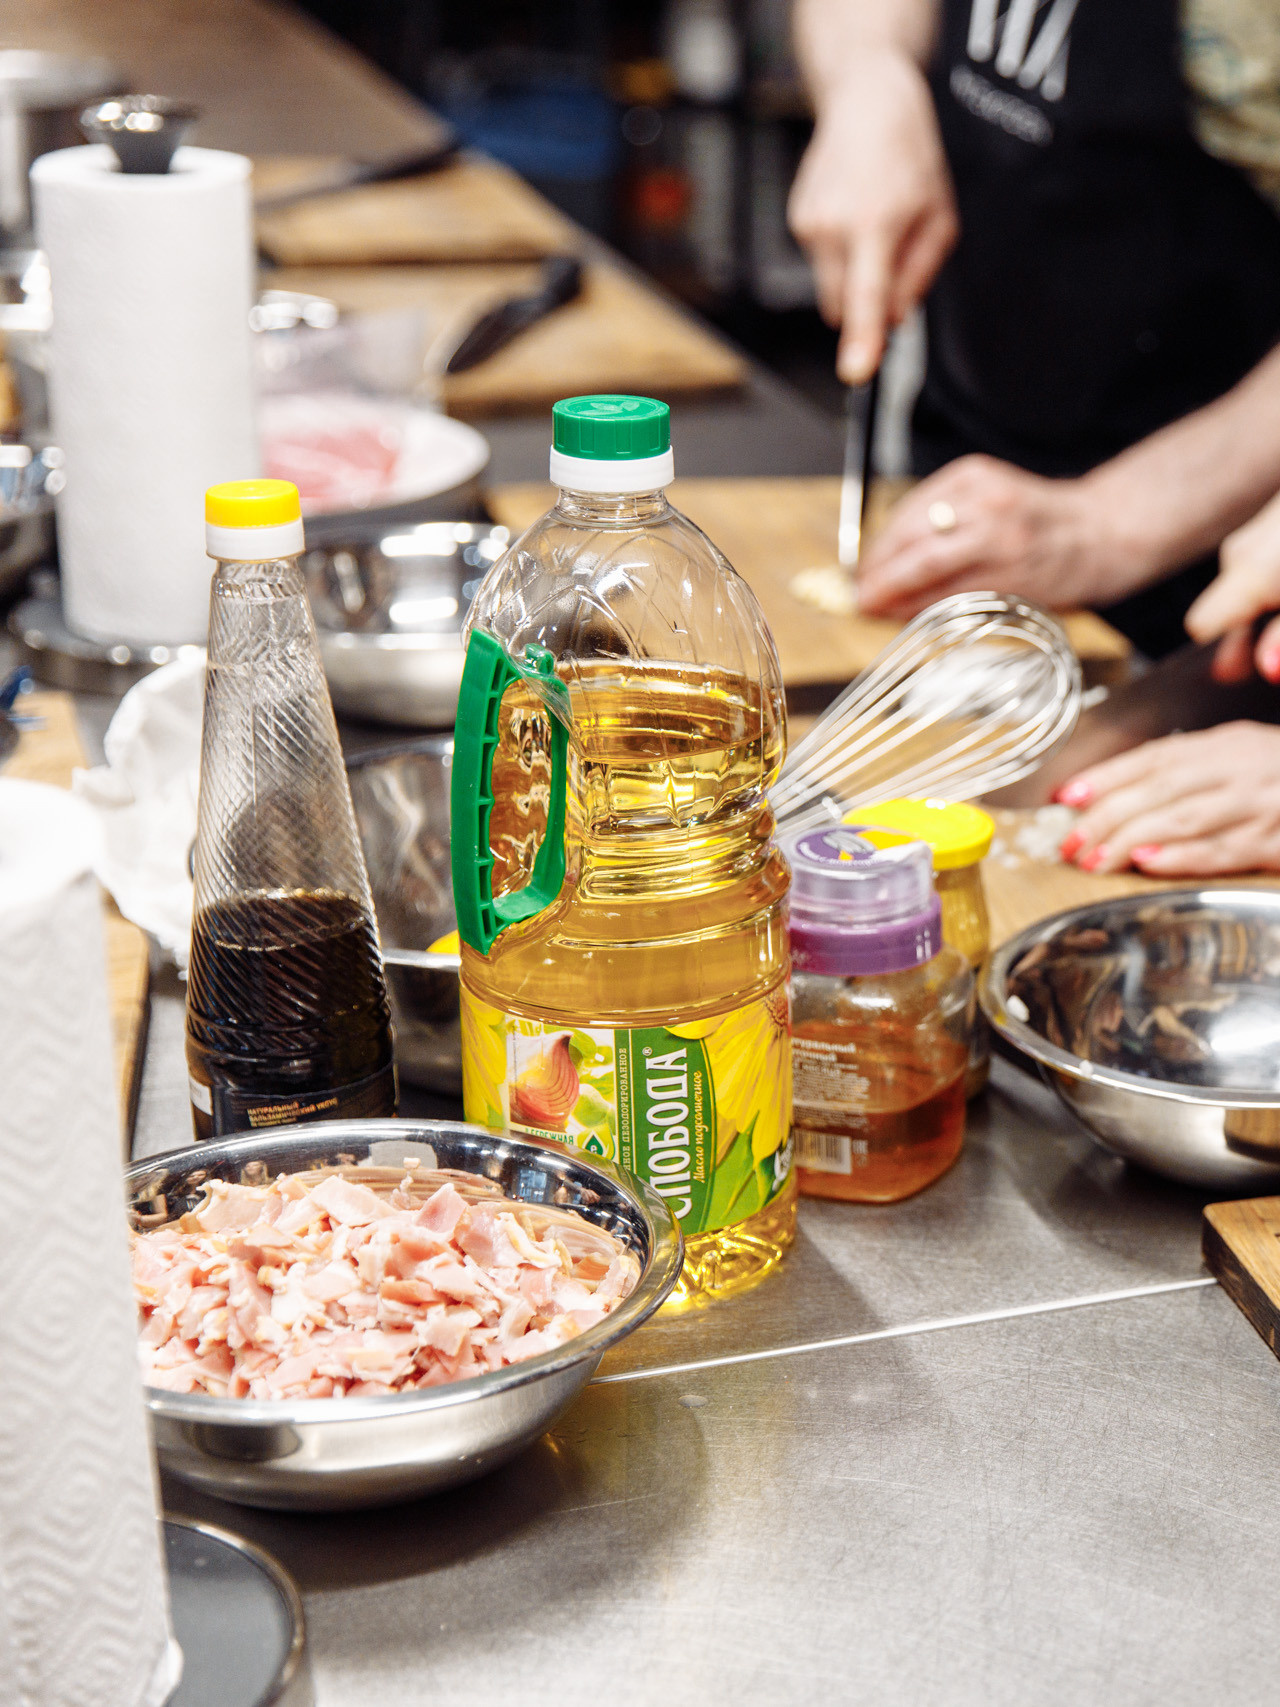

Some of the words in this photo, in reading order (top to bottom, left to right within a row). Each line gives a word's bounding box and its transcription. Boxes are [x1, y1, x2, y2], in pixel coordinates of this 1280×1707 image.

[619, 1047, 630, 1143] ДЕЗОДОРИРОВАННОЕ
[692, 1070, 709, 1145] подсолнечное
[693, 1146, 706, 1184] Масло
